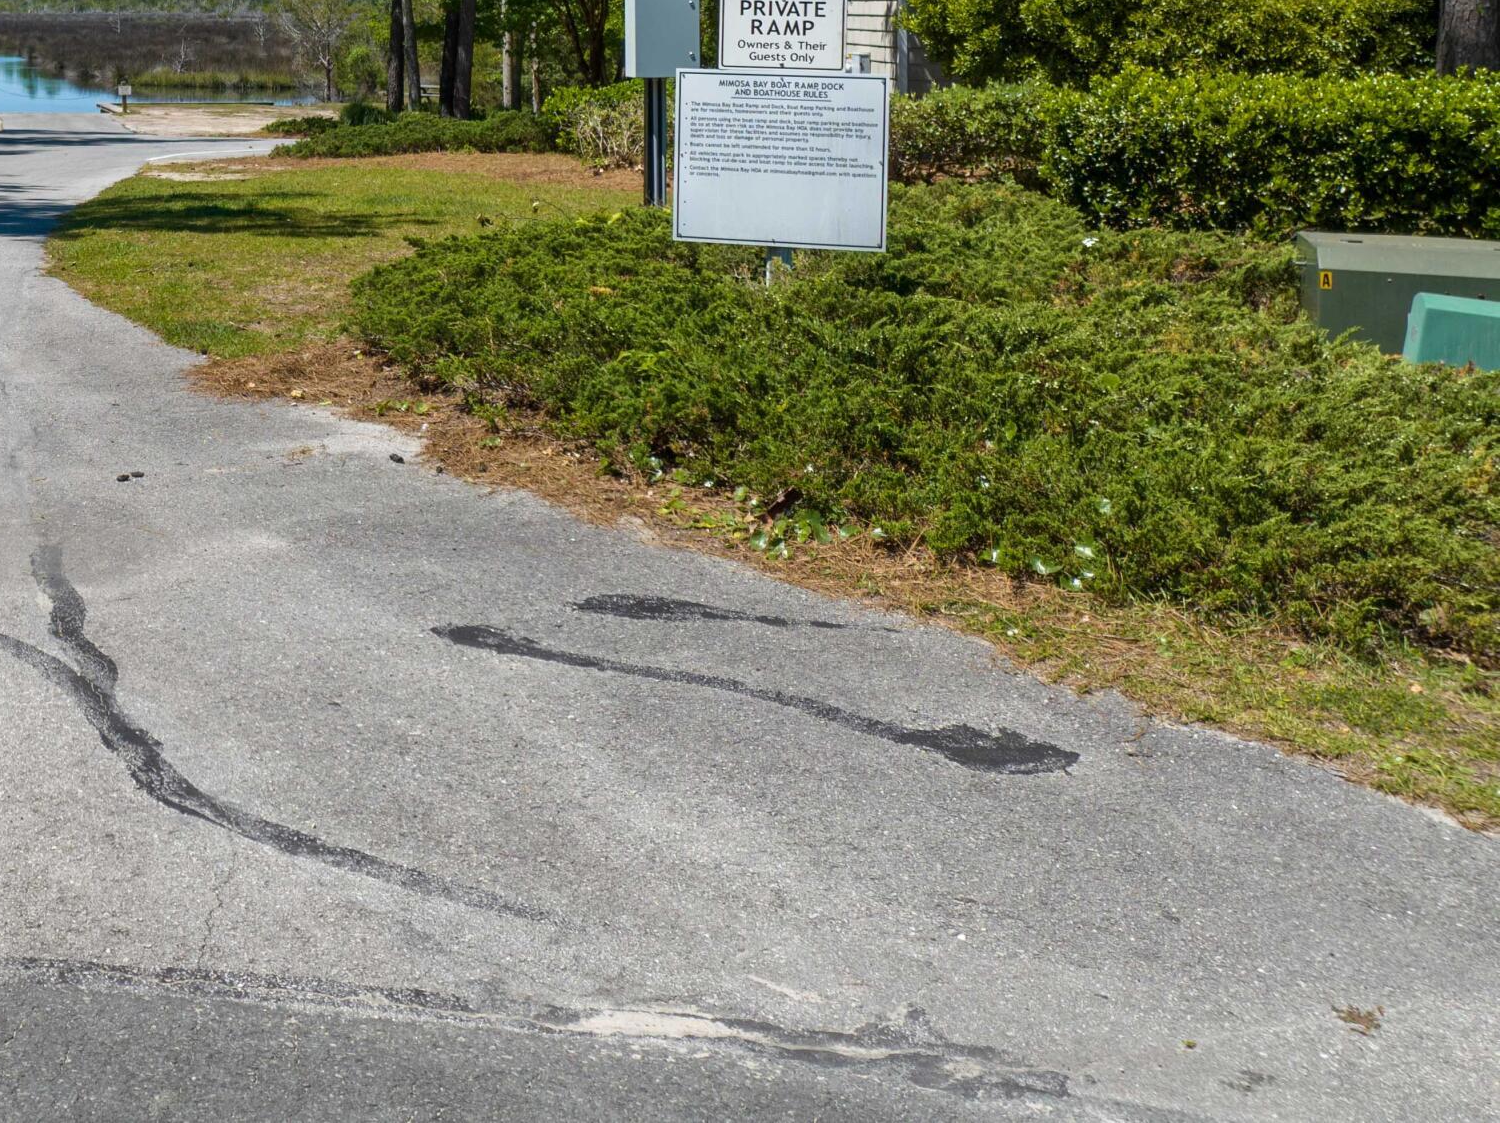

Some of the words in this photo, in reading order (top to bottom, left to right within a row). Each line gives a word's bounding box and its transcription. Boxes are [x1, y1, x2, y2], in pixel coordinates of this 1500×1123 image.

[740, 0, 826, 17] PRIVATE
[751, 19, 814, 36] RAMP
[738, 39, 780, 49] Owners
[784, 41, 792, 50] &
[798, 41, 827, 51] Their
[749, 51, 786, 61] Guests
[790, 53, 814, 64] Only
[771, 81, 791, 89] BOAT
[822, 83, 844, 91] DOCK
[754, 89, 801, 97] BOATHOUSE
[1322, 273, 1330, 287] A
